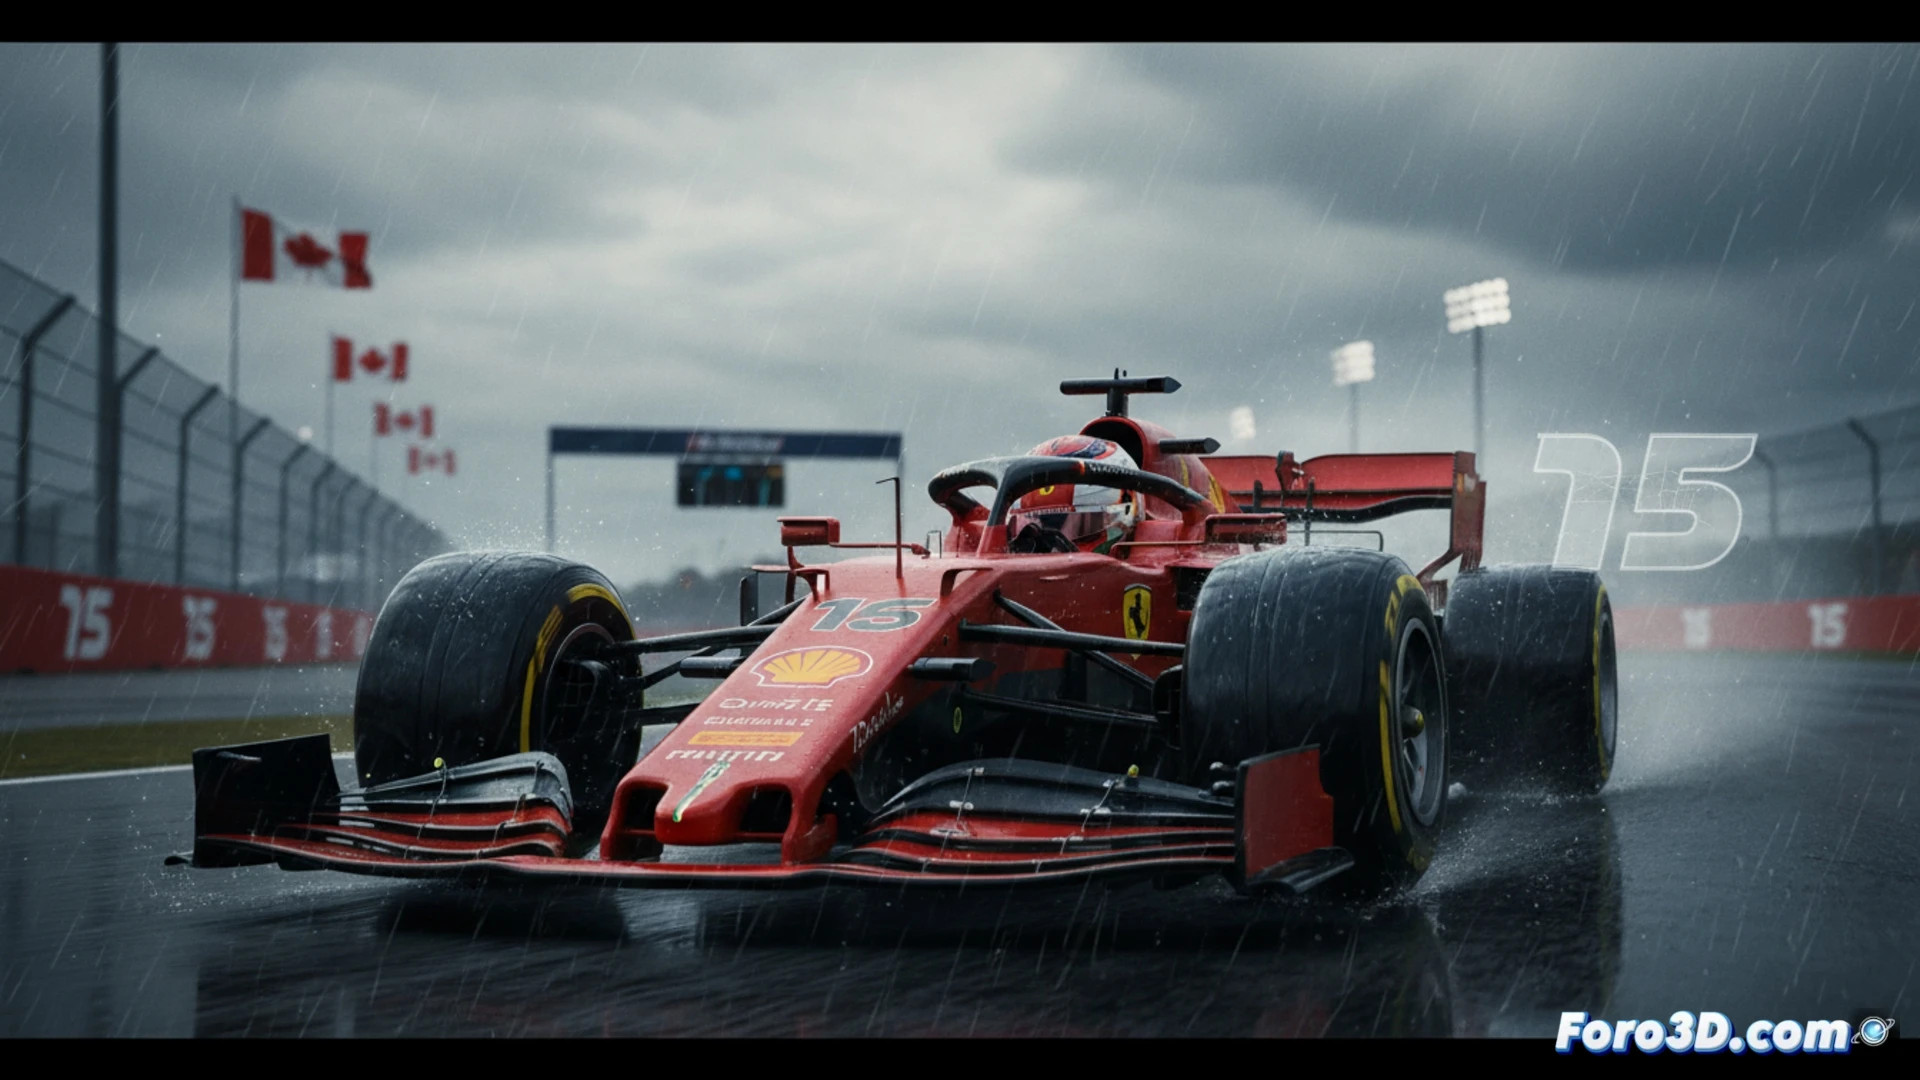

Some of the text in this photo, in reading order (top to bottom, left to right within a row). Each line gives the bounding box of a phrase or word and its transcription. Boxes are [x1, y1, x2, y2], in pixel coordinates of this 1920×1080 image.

[59, 584, 114, 661] 15
[810, 597, 938, 632] 15
[1808, 603, 1848, 648] 15
